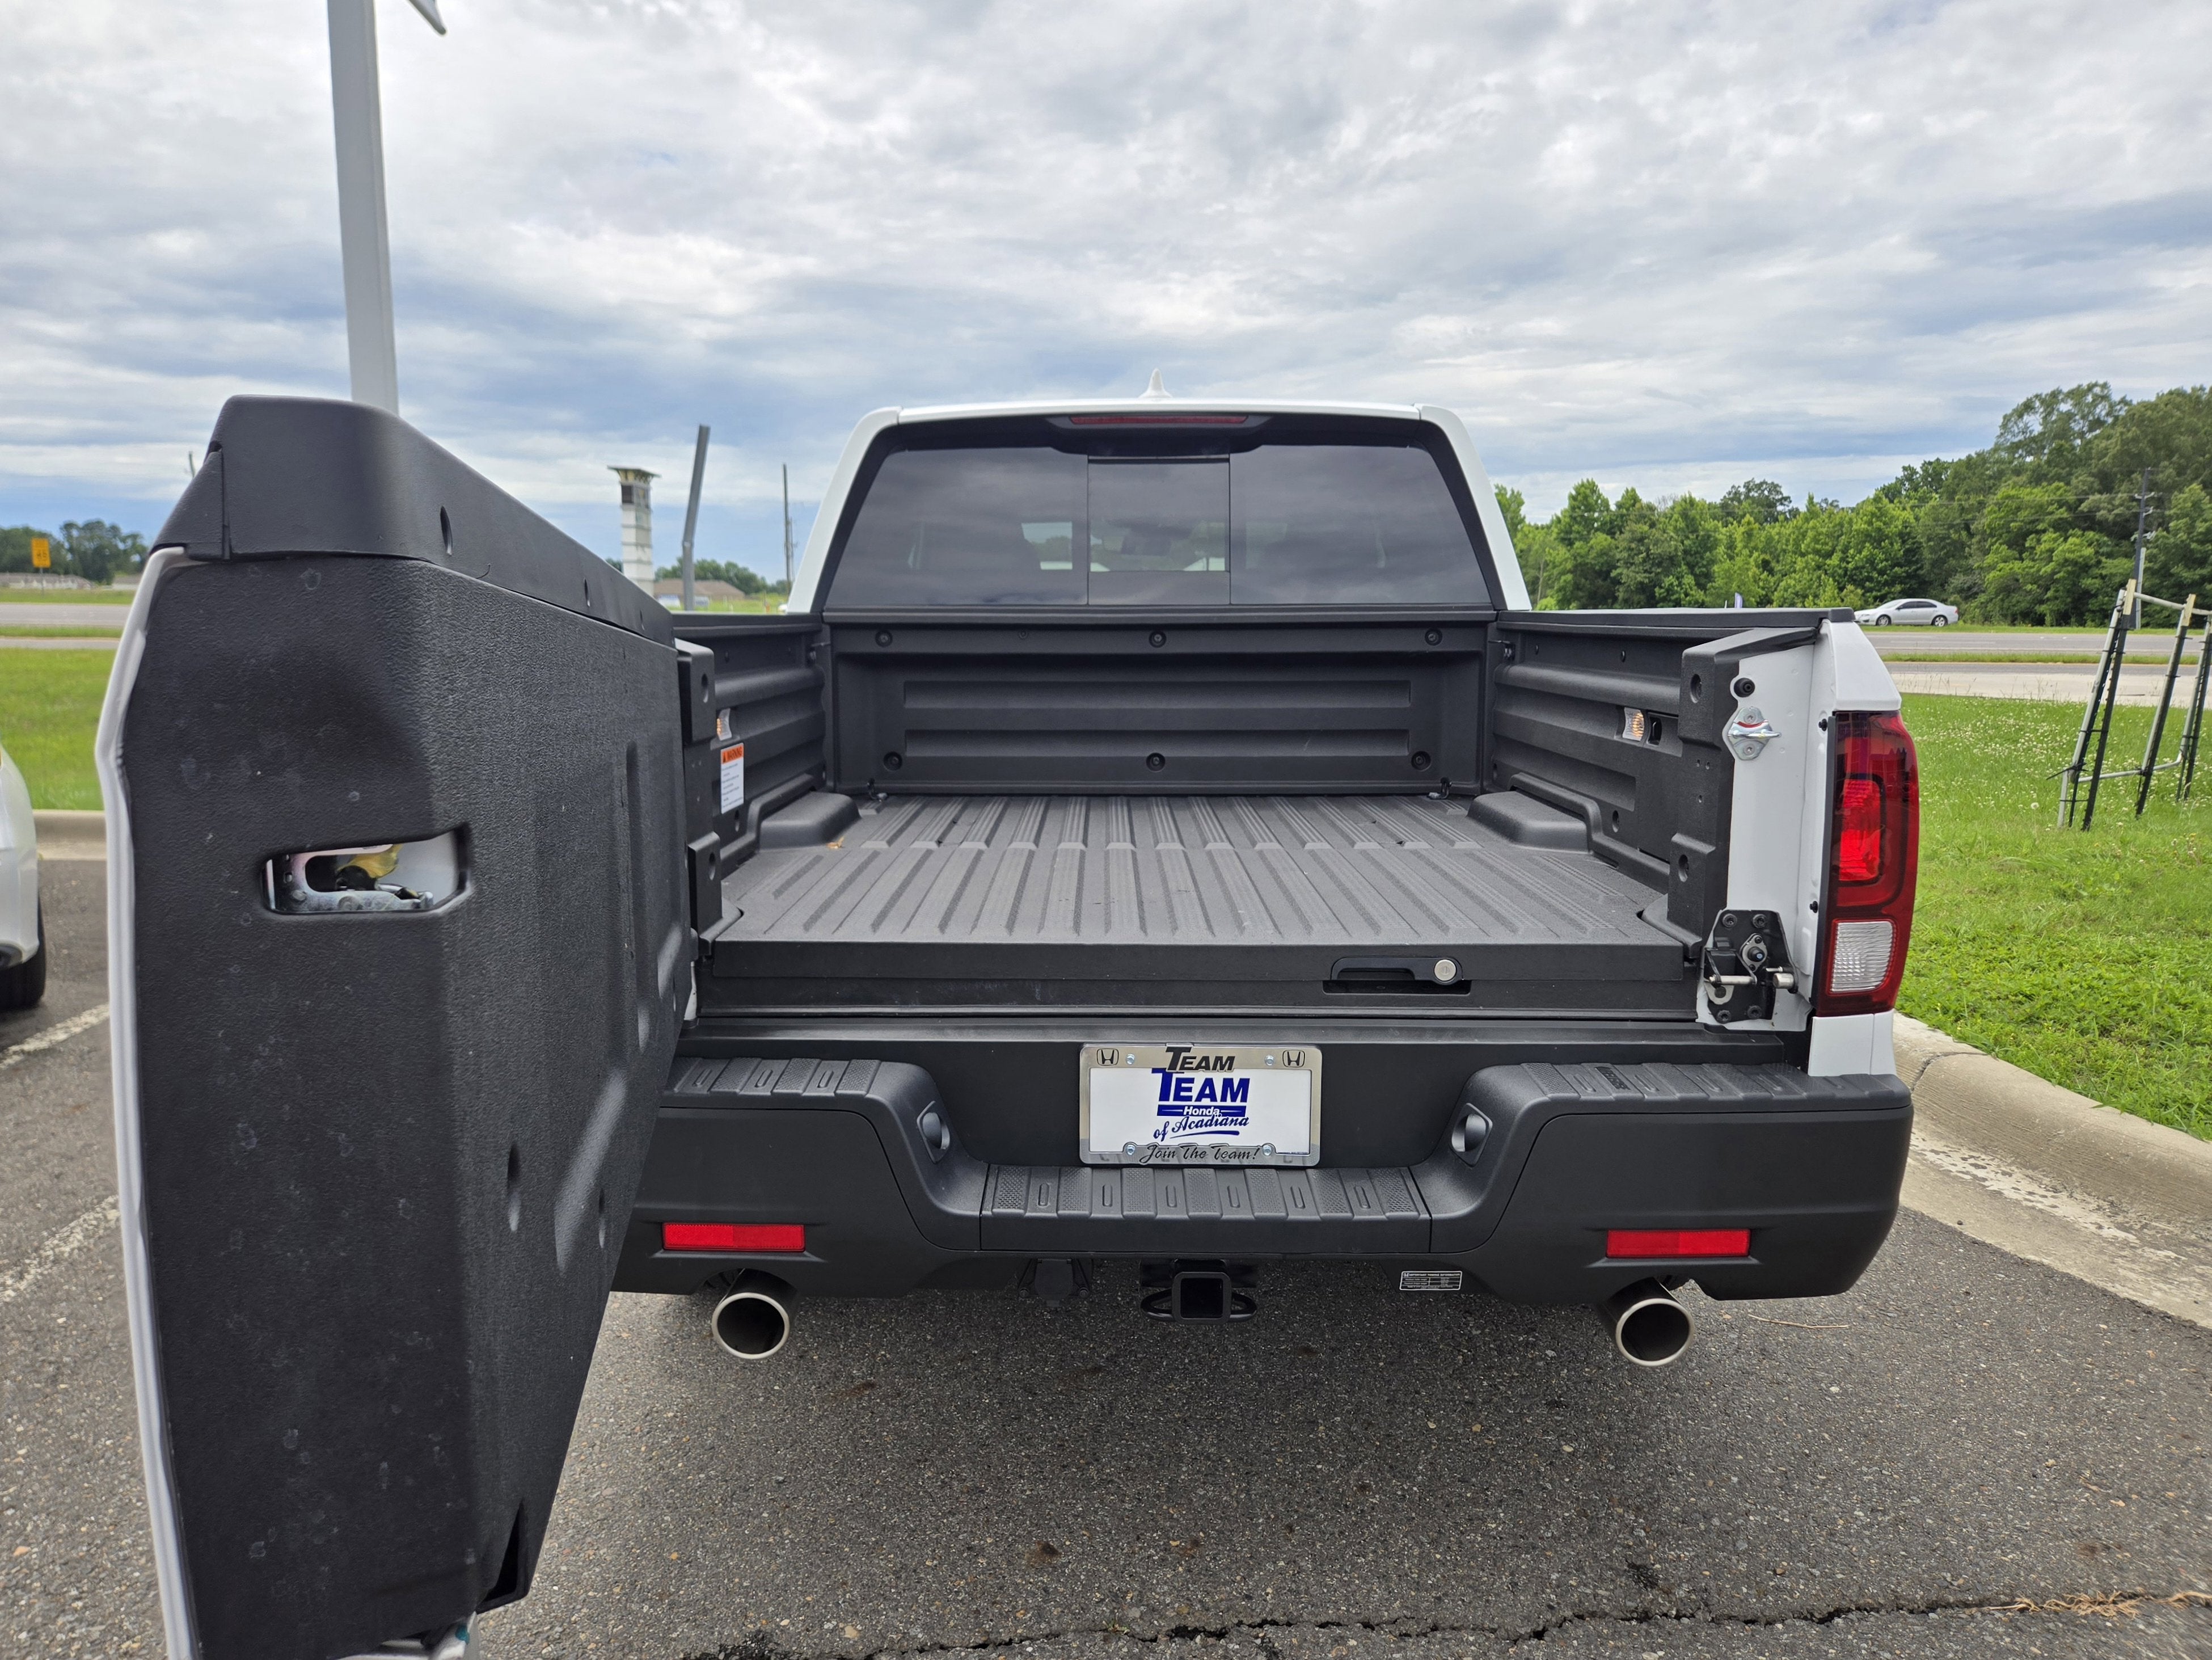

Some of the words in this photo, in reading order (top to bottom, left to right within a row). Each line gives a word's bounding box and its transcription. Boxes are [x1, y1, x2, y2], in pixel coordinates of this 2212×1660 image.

[1166, 1046, 1235, 1071] TEAM
[1151, 1068, 1250, 1102] TEAM
[1183, 1106, 1220, 1116] Honda
[1153, 1121, 1170, 1142] of
[1171, 1114, 1249, 1133] Acadiana
[1139, 1144, 1177, 1163] Join
[1180, 1145, 1208, 1160] The
[1210, 1145, 1260, 1160] Team!
